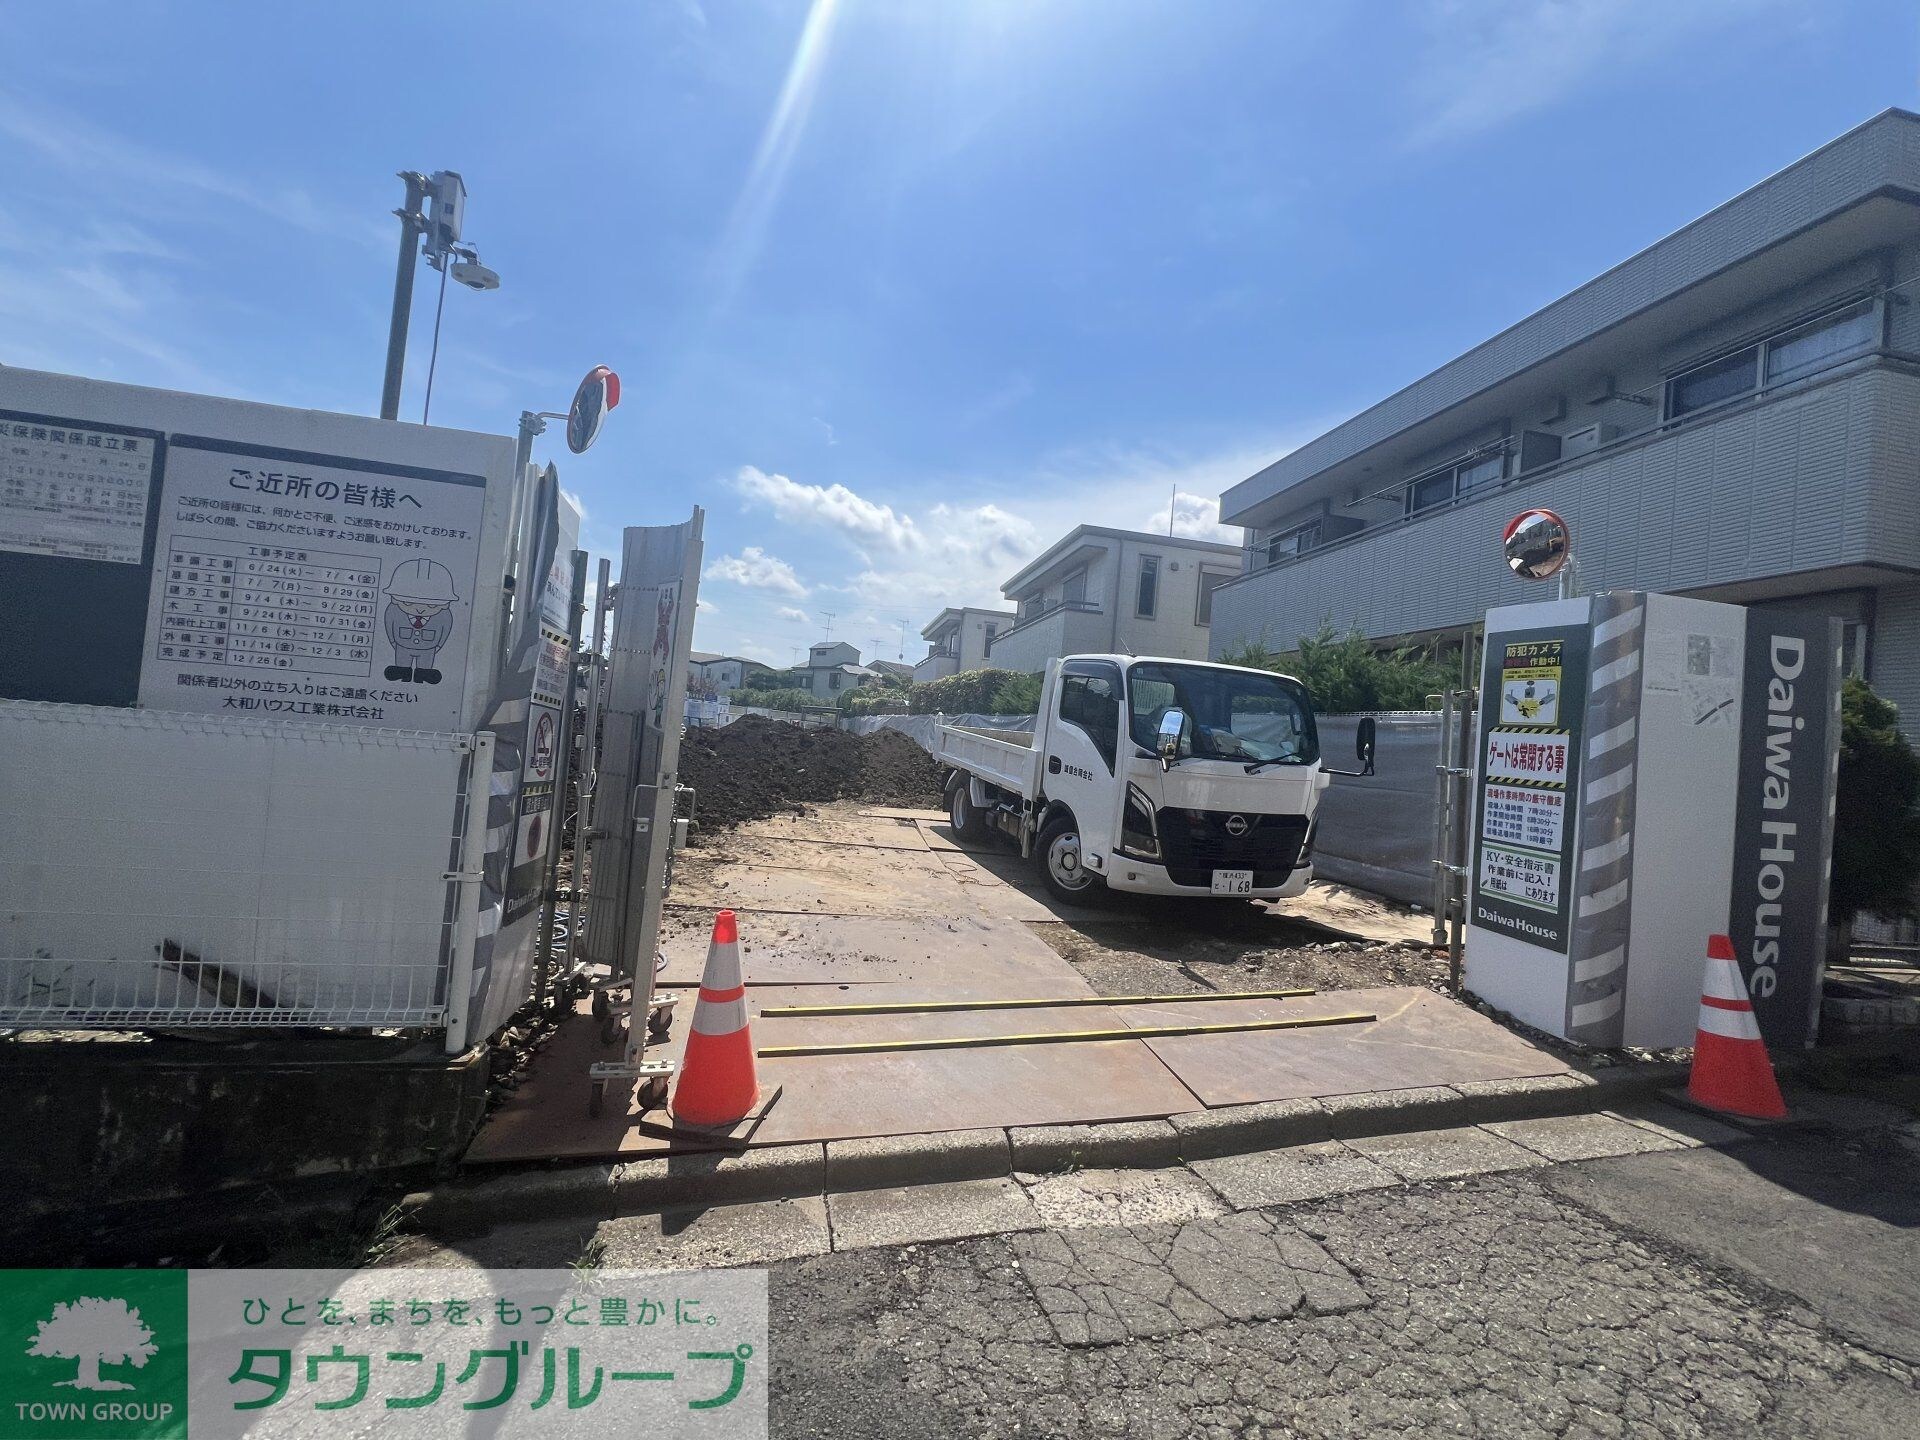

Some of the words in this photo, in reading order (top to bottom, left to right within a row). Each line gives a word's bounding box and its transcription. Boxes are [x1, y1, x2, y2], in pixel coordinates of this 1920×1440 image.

[229, 469, 422, 509] ご近所の皆様へ
[248, 546, 307, 562] 工事予定表
[1506, 643, 1561, 657] 防犯カメラ
[177, 673, 418, 704] 関係者以外の立ち入りはご遠慮ください
[222, 696, 384, 720] 大和ハウス工業株式会社
[1763, 635, 1805, 810] Daiwa
[1490, 741, 1565, 774] ゲートは常閉する事
[1525, 886, 1555, 903] にあります
[1750, 821, 1797, 998] House
[1478, 906, 1515, 928] Daiwa
[1516, 918, 1558, 941] House
